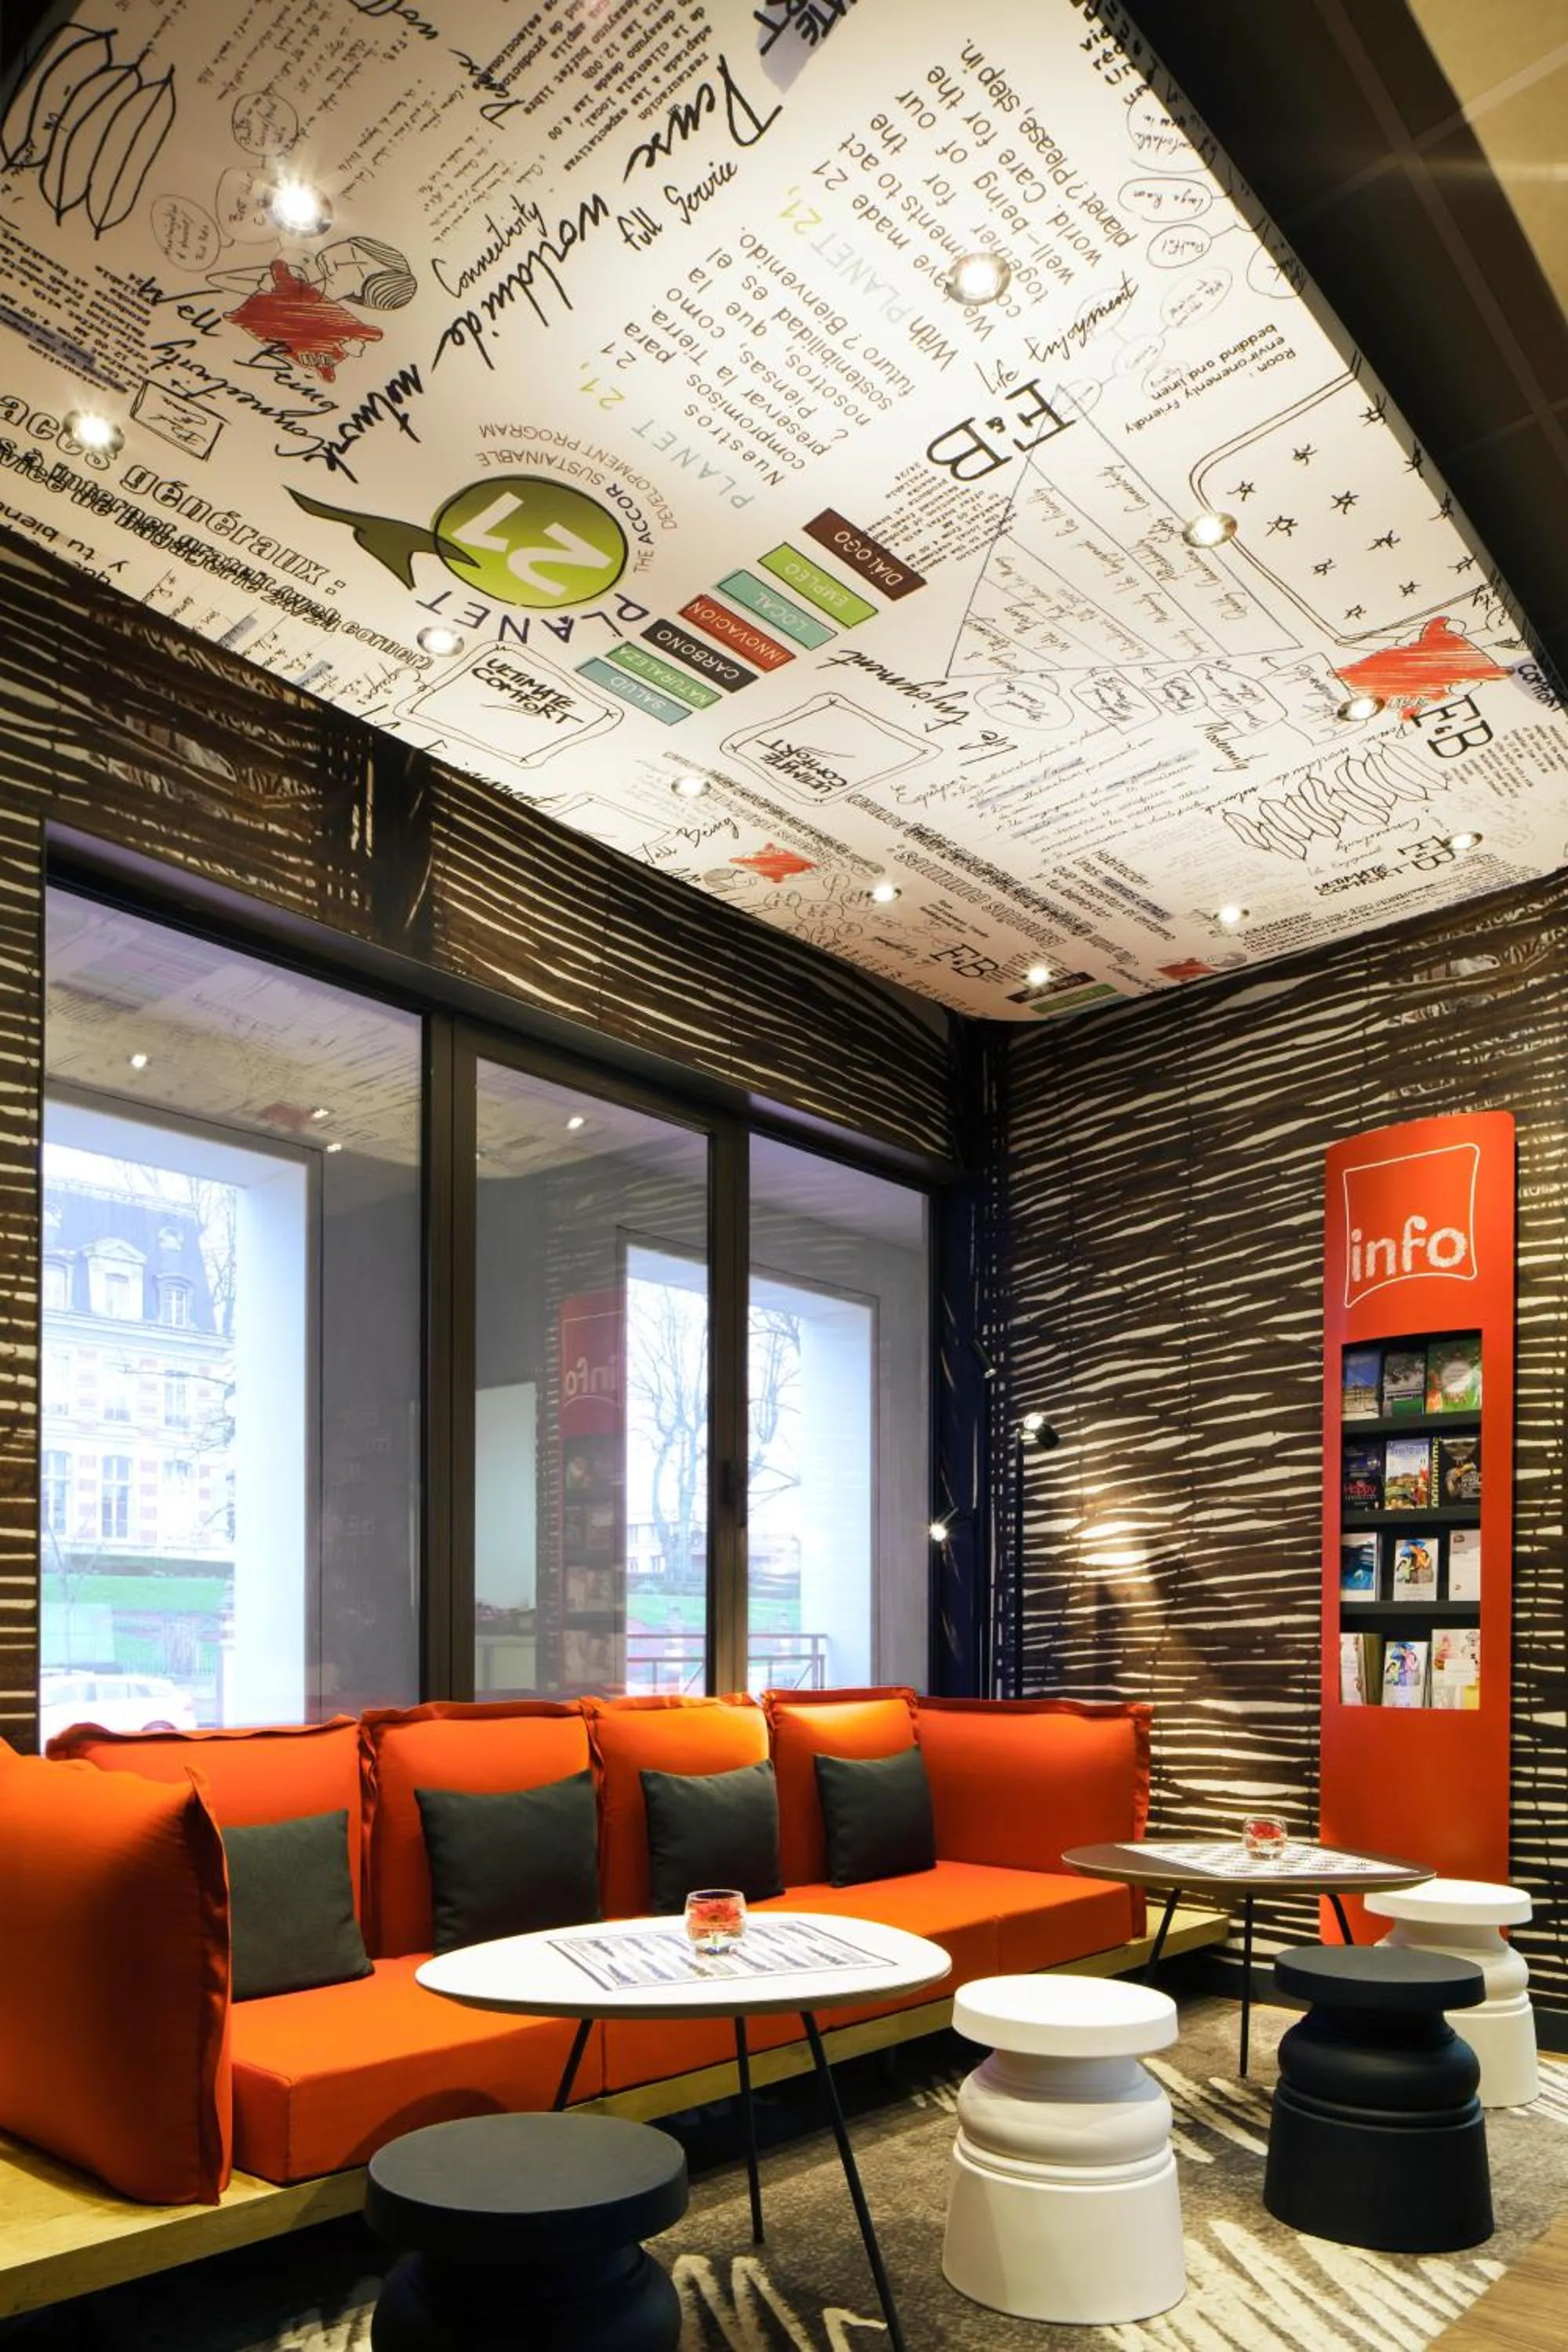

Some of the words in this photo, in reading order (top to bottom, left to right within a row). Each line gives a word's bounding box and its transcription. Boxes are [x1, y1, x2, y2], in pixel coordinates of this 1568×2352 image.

[626, 9, 676, 60] desayuno
[662, 24, 713, 74] adaptada
[553, 45, 592, 84] buffet
[593, 60, 625, 93] desde
[615, 41, 670, 95] clientela
[927, 65, 965, 111] the
[977, 66, 1021, 113] step
[522, 85, 555, 116] libre
[630, 86, 652, 107] las
[894, 89, 937, 130] our
[563, 107, 629, 172] expectativas
[837, 132, 880, 172] act
[869, 113, 908, 156] the
[935, 140, 968, 165] of
[961, 111, 998, 148] for
[1018, 107, 1078, 187] Please,
[811, 159, 849, 191] 21
[877, 172, 903, 200] to
[921, 173, 957, 207] for
[997, 148, 1047, 204] Care
[779, 185, 824, 235] 21,
[851, 194, 911, 251] made
[705, 247, 733, 270] el
[894, 187, 1024, 327] cotments
[1045, 204, 1102, 268] world.
[688, 267, 713, 295] la
[739, 227, 849, 336] Bienvenido.
[741, 275, 769, 301] es
[809, 233, 913, 324] PLANET
[651, 304, 709, 367] Tierra.
[666, 288, 726, 339] como
[725, 301, 768, 337] que
[963, 301, 996, 343] We
[599, 341, 637, 370] 21
[623, 321, 677, 365] para
[770, 306, 893, 411] sostenibilidad
[908, 315, 959, 372] With
[579, 361, 626, 411] 21,
[716, 365, 739, 387] la
[739, 342, 819, 420] Piensas,
[785, 345, 872, 427] nosotros,
[862, 347, 916, 397] futuro
[322, 364, 424, 485] network
[479, 423, 582, 452] PROGRAM
[684, 404, 786, 487] Nuestros
[686, 373, 806, 470] compromisos
[740, 388, 832, 457] preservar
[477, 451, 608, 493] SUSTAINABLE
[583, 435, 679, 530] DEVELOPMENT
[630, 419, 756, 510] PLANET
[118, 464, 331, 586] généraux
[604, 481, 655, 546] ACCOR
[452, 492, 615, 597] 21
[779, 556, 855, 611] EMPLEO
[416, 590, 650, 645] PLANET
[748, 590, 810, 633] LOCAL
[615, 644, 712, 706] NATURALEZA
[652, 624, 742, 684] CARBONO
[470, 666, 585, 725] COMFORT
[487, 657, 577, 709] ULTIMATE
[606, 673, 670, 711] SALUD
[816, 648, 971, 735] Enjoyment
[1350, 1214, 1468, 1283] info
